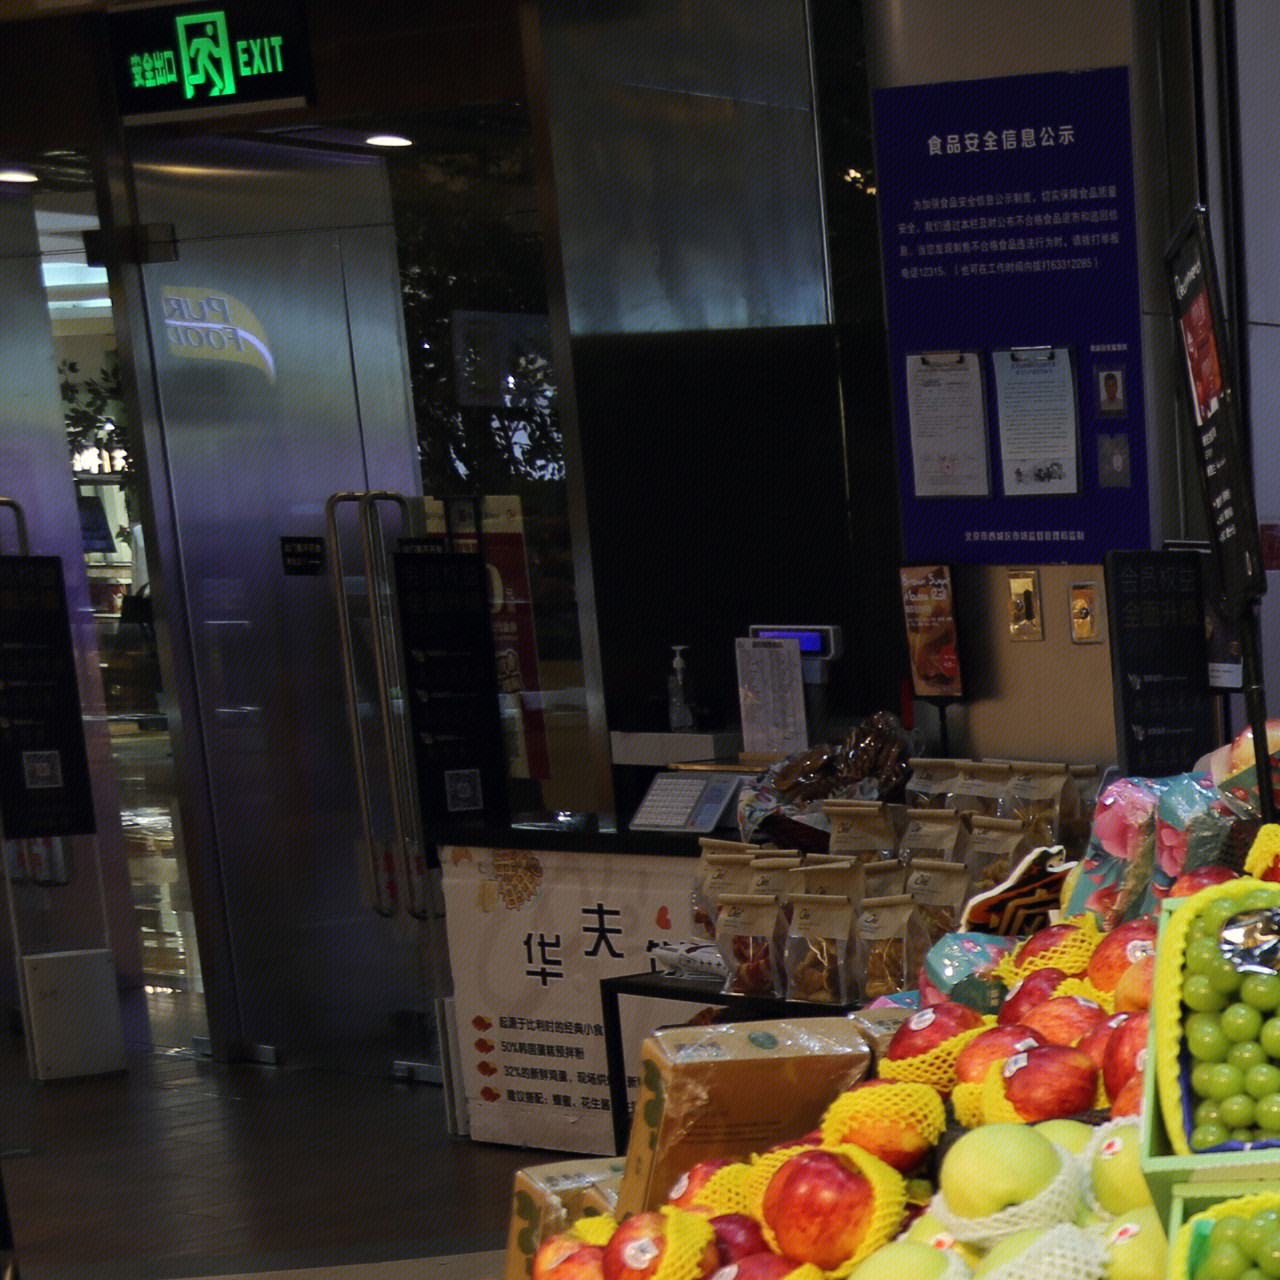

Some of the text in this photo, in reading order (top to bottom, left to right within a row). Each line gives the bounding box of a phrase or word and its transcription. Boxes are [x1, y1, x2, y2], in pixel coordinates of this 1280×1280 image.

[130, 50, 178, 88] 安全出口
[236, 36, 284, 77] EXIT
[928, 124, 1076, 156] 食品安全信息公示
